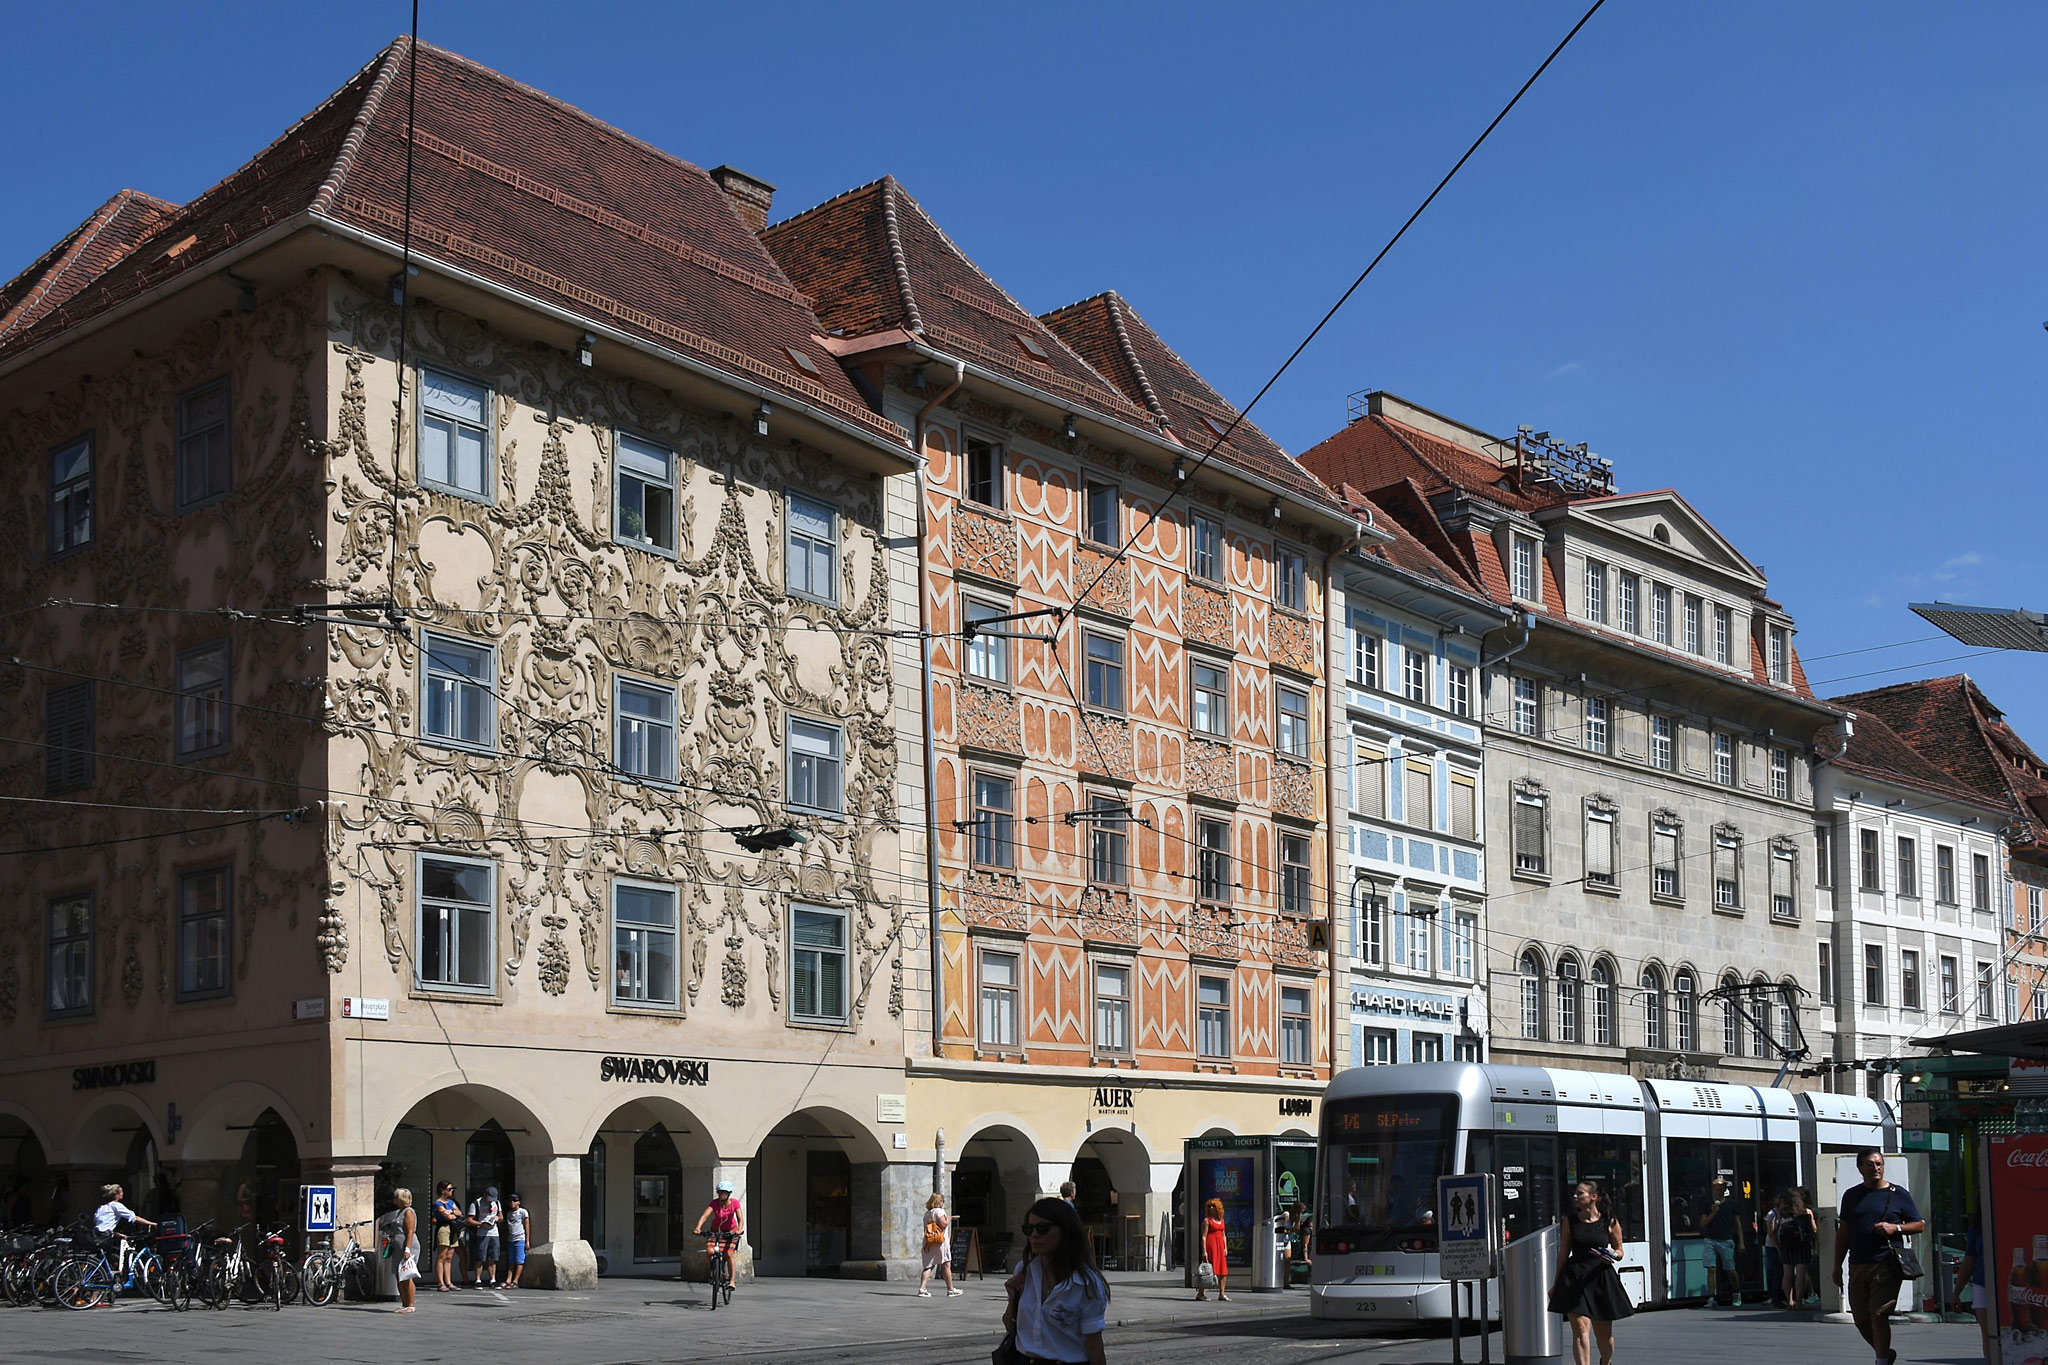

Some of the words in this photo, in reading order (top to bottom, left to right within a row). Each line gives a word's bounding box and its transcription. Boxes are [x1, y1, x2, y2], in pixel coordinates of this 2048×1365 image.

[1312, 925, 1325, 946] A
[72, 1060, 156, 1090] SWAROVSKI
[600, 1056, 709, 1085] SWAROVSKI
[1093, 1088, 1134, 1107] AUER
[1545, 1115, 1557, 1124] 223
[1234, 1138, 1261, 1146] TICKETS
[1215, 1170, 1238, 1178] BLUE
[1215, 1178, 1238, 1187] MAN
[1356, 1302, 1377, 1312] 223
